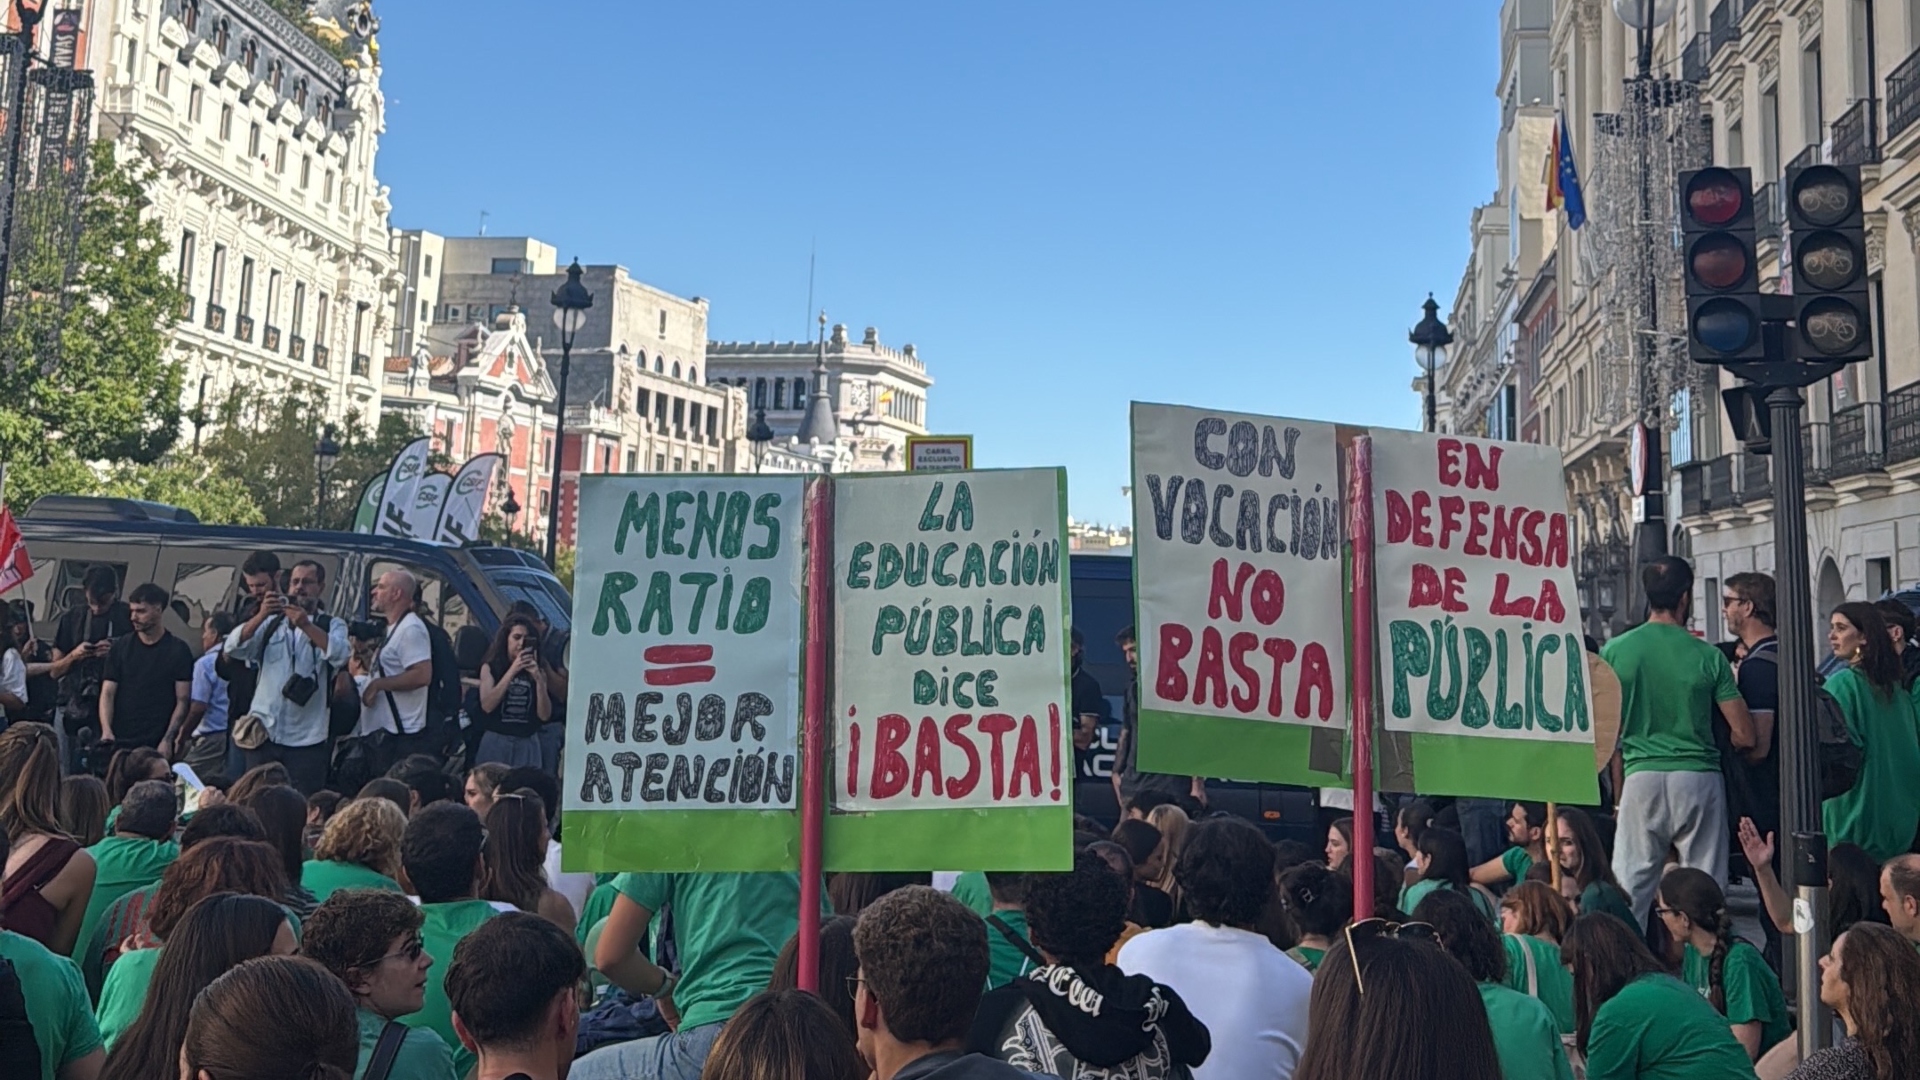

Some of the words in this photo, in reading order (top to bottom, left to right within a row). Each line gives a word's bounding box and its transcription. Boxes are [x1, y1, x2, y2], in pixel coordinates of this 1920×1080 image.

[1195, 417, 1300, 479] CON
[1438, 439, 1503, 491] EN
[615, 490, 781, 559] MENOS
[918, 481, 973, 532] LA
[1147, 474, 1339, 560] VOCACIÓN
[1385, 490, 1569, 568] DEFENSA
[847, 529, 1059, 589] EDUCACIÓN
[592, 567, 771, 636] RATIO
[1208, 558, 1284, 625] NO
[1409, 563, 1468, 612] DE
[1490, 573, 1565, 623] LA
[872, 598, 1045, 656] PÚBLICA
[1156, 623, 1333, 721] BASTA
[1389, 614, 1589, 732] PÚBLICA
[585, 692, 774, 745] MEJOR
[580, 747, 794, 804] ATENCIÓN
[847, 703, 1061, 801] ¡BASTA!
